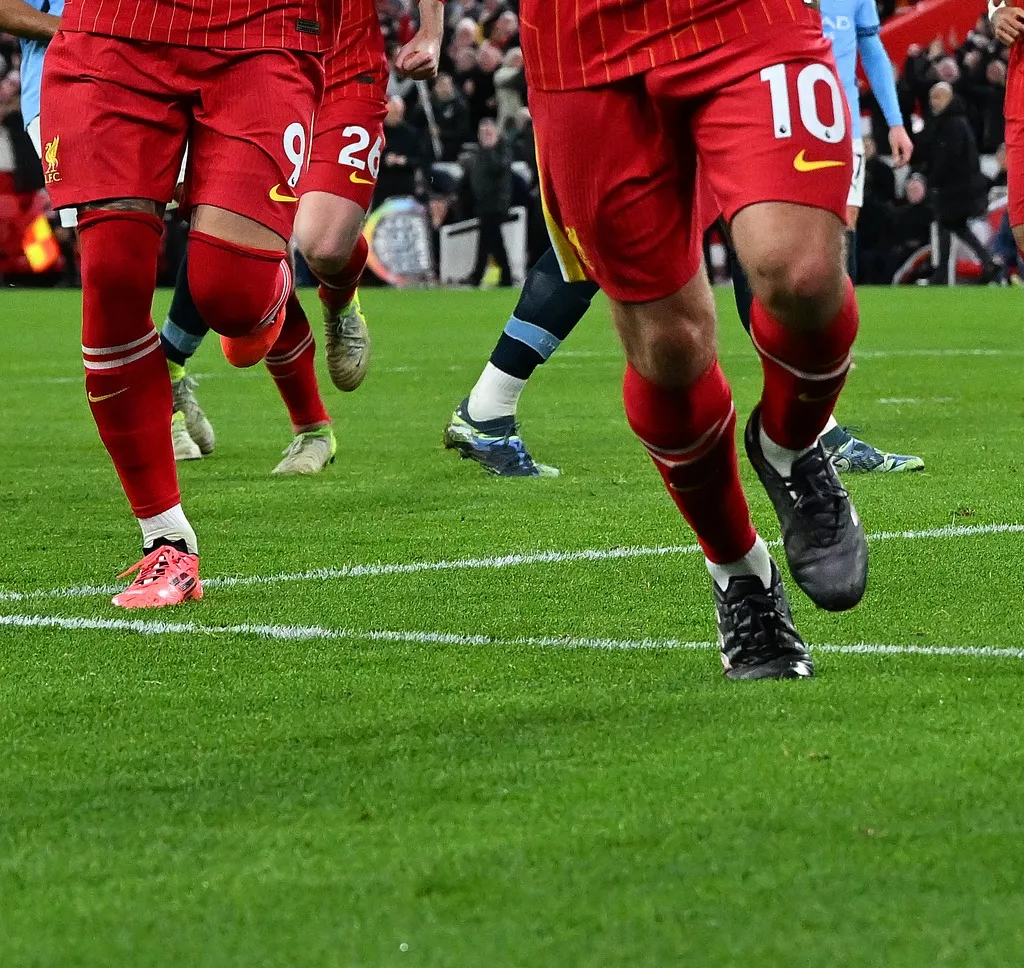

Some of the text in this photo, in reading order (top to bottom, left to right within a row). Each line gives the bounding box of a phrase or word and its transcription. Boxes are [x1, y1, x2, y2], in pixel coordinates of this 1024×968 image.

[760, 63, 846, 143] 10
[283, 122, 306, 188] 9
[338, 126, 382, 179] 26
